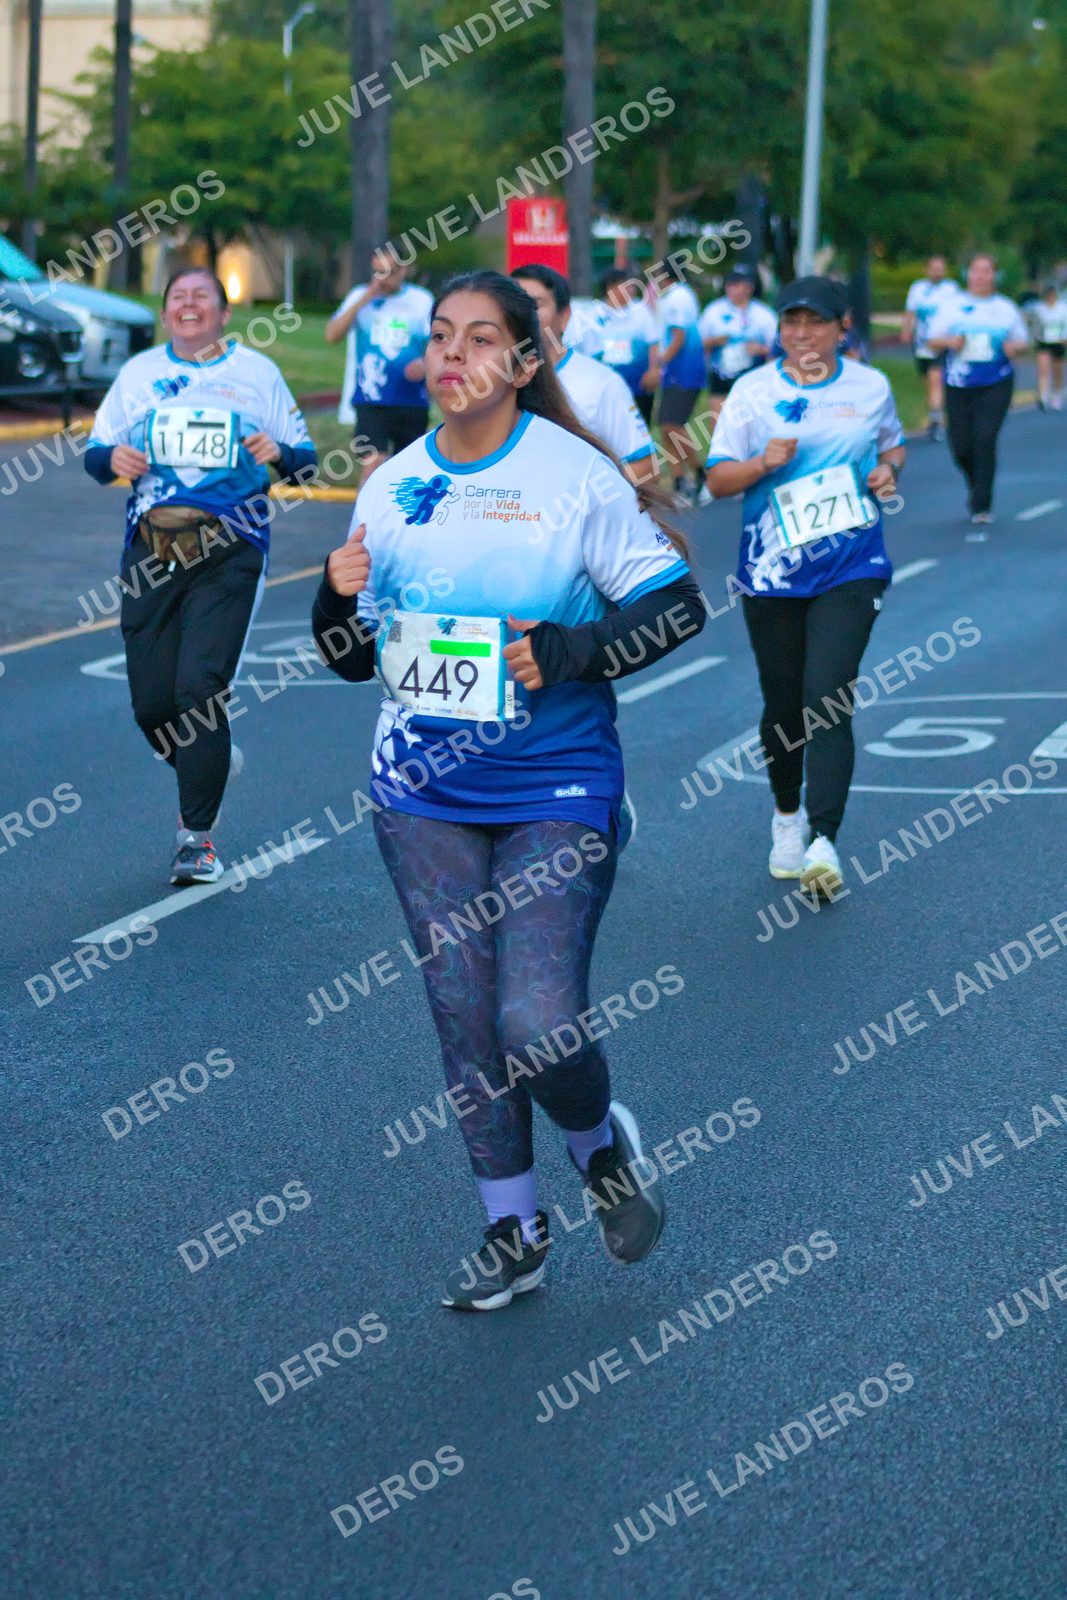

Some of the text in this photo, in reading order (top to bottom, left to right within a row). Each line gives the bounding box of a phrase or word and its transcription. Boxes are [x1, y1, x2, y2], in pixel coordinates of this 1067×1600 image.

[159, 431, 226, 459] 1148
[463, 499, 521, 510] por la Vida
[465, 485, 521, 499] Carrera
[463, 509, 540, 522] y la Integridad
[787, 492, 855, 535] 1271
[398, 655, 479, 703] 449
[863, 717, 1006, 758] 5
